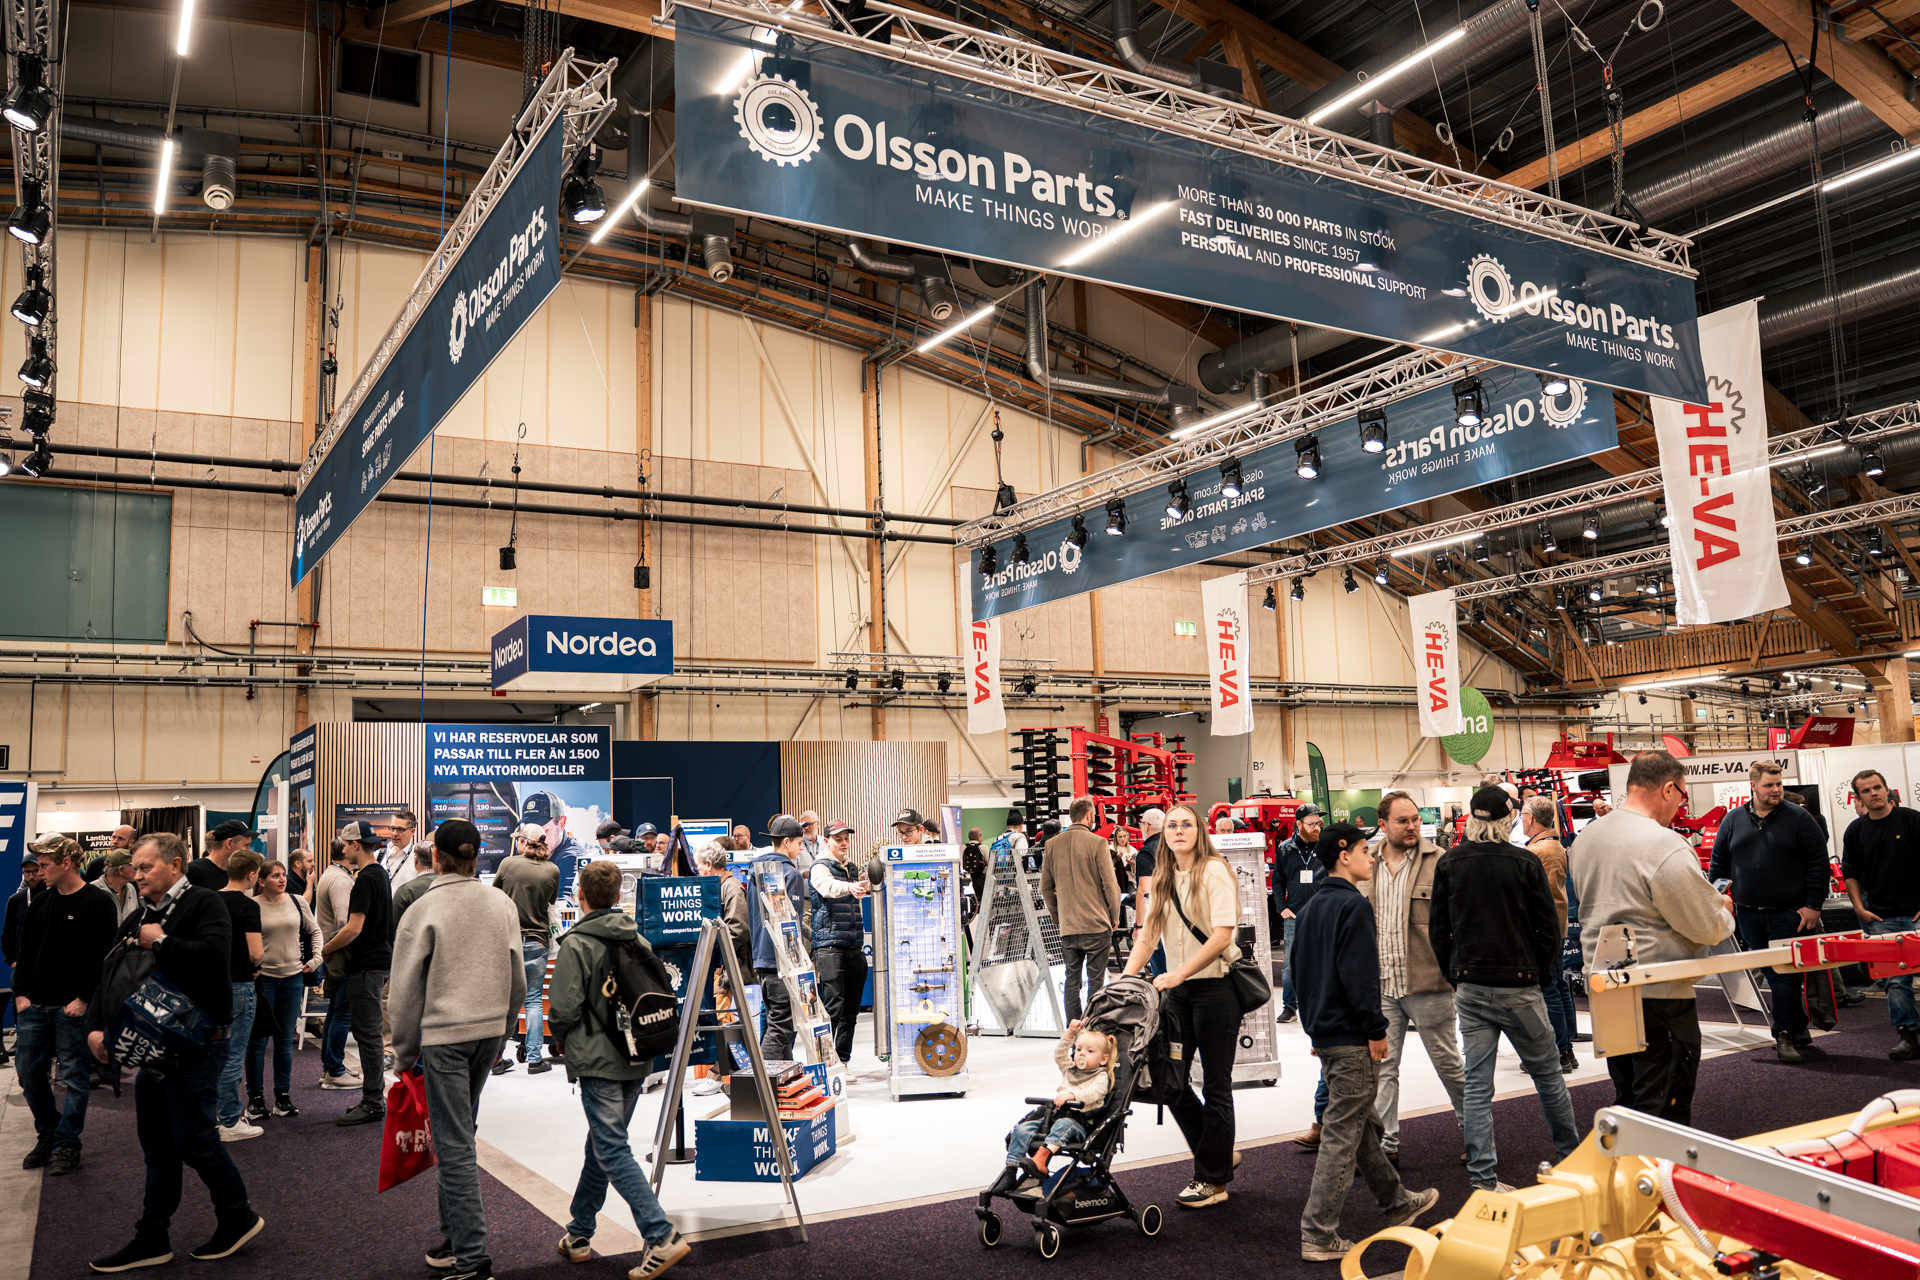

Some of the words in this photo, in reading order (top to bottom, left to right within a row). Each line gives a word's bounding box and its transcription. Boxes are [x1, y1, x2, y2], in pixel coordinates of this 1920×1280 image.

[834, 113, 996, 191] Olsson
[916, 184, 974, 213] MAKE
[982, 198, 1055, 230] THINGS
[1061, 215, 1117, 244] WORK
[1178, 184, 1217, 207] MORE
[1219, 194, 1253, 216] THAN
[1256, 204, 1274, 220] 30
[1276, 209, 1301, 227] 000
[1303, 216, 1342, 238] PARTS
[1345, 226, 1358, 241] IN
[1360, 230, 1396, 251] STOCK
[1179, 207, 1213, 228] FAST
[1216, 217, 1291, 247] DELIVERIES
[1293, 235, 1329, 256] SINCE
[1331, 245, 1361, 263] 1957
[1181, 231, 1253, 260] PERSONAL
[1255, 249, 1282, 267] AND
[1284, 255, 1376, 288] PROFESSIONAL
[1377, 277, 1427, 300] SUPPORT
[469, 256, 508, 327] Olsson
[486, 300, 501, 332] MAKE
[502, 272, 525, 311] THINGS
[524, 245, 545, 282] WORK
[1520, 280, 1609, 334] Olsson
[1566, 332, 1598, 352] MAKE
[1601, 340, 1642, 361] THINGS
[1645, 350, 1676, 370] WORK
[1683, 402, 1741, 571] HE-VA
[494, 637, 523, 670] Nordea
[547, 631, 657, 656] Nordea
[1217, 620, 1239, 709] HE-VA
[1425, 632, 1449, 713] HE-VA
[434, 732, 446, 743] VI
[449, 732, 476, 743] HAR
[479, 733, 568, 744] RESERVDELAR
[570, 733, 598, 744] SOM
[434, 749, 484, 760] PASSAR
[486, 749, 512, 759] TILL
[515, 749, 546, 759] FLER
[548, 747, 565, 760] ÄN
[569, 749, 600, 760] 1500
[1253, 761, 1265, 771] B2
[434, 765, 458, 776] NYA
[461, 765, 585, 776] TRAKTORMODELLER
[1333, 808, 1349, 817] dina
[86, 834, 112, 842] Lantbru
[660, 885, 701, 899] MAKE
[661, 899, 702, 910] THINGS
[639, 1008, 674, 1026] umbr
[114, 1026, 138, 1063] AKE
[127, 1036, 150, 1066] INGS
[810, 1111, 827, 1129] MAKE
[753, 1127, 800, 1143] MKE
[811, 1124, 828, 1144] THINGS
[754, 1144, 797, 1159] THIGS
[754, 1161, 801, 1177] WOK.
[1075, 1198, 1109, 1209] beemoo
